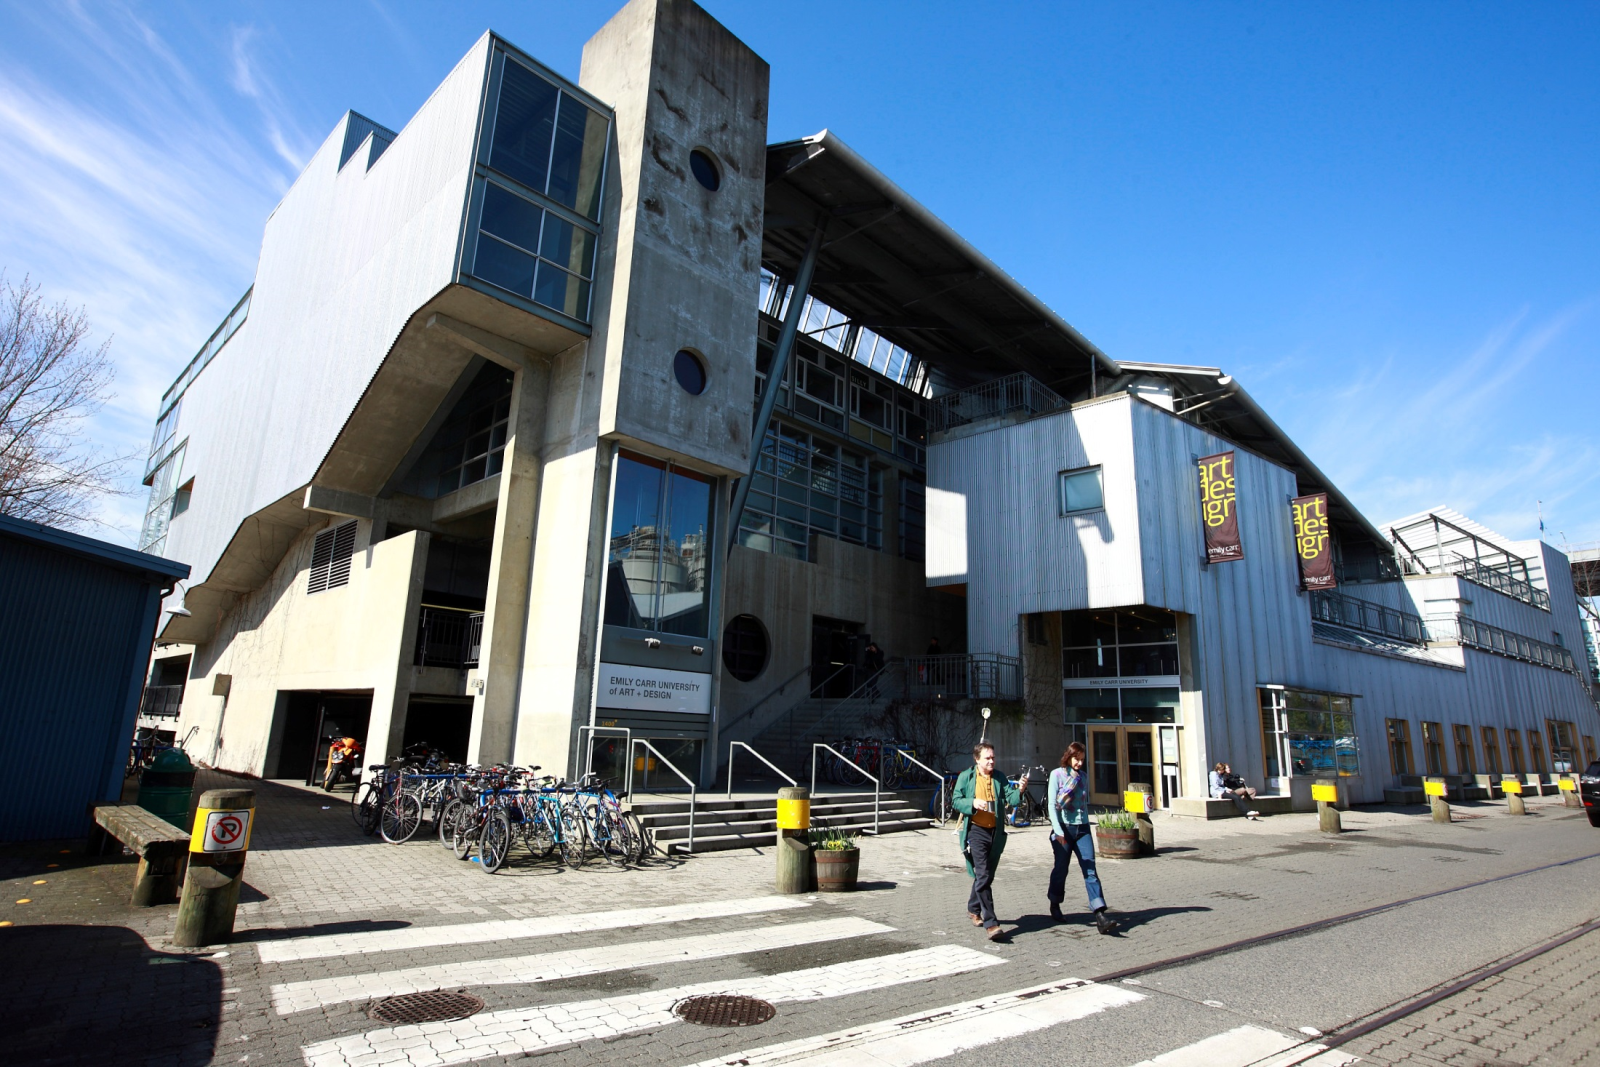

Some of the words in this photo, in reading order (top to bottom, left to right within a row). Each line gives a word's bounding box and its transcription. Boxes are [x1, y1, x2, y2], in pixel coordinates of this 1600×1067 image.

[1208, 546, 1225, 555] emily
[1225, 544, 1239, 552] carr
[610, 676, 634, 686] EMILY
[635, 679, 657, 688] CARR
[658, 681, 700, 692] UNIVERSITY
[609, 687, 618, 695] of
[619, 688, 635, 697] ART
[643, 690, 672, 699] DESIGN
[220, 822, 238, 839] P
